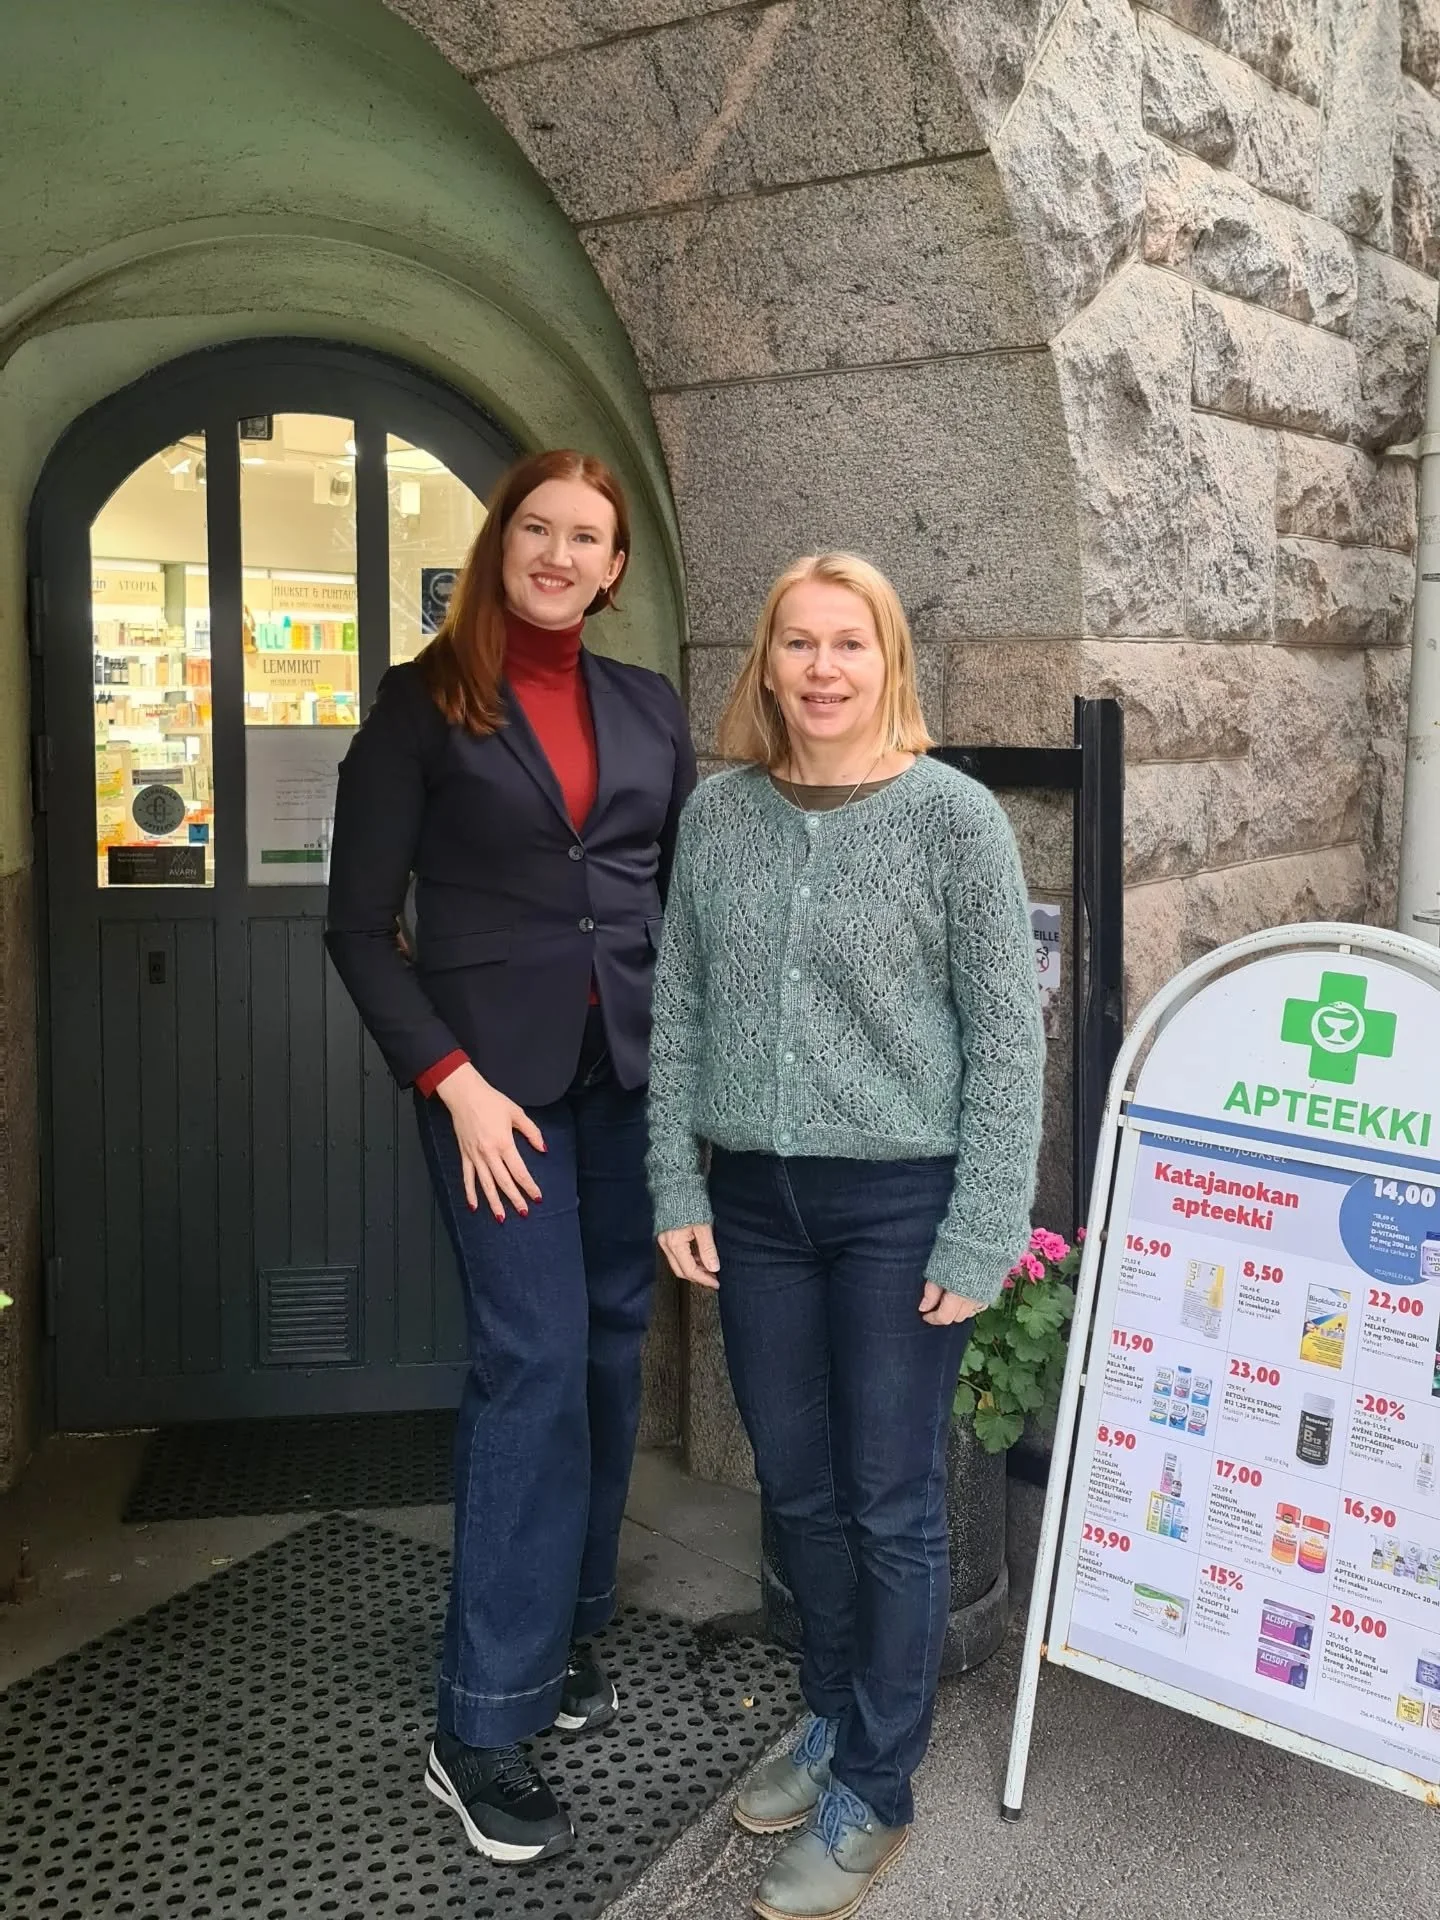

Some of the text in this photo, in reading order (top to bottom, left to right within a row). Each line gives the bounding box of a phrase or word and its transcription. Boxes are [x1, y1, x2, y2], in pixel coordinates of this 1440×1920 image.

[263, 659, 320, 674] LEMMIKIT
[1223, 1082, 1432, 1146] APTEEKKI
[1154, 1162, 1300, 1208] Katajanokan
[1374, 1178, 1436, 1208] 14,00
[1172, 1195, 1274, 1231] apteekki
[1372, 1221, 1399, 1231] DEVISOL
[1126, 1234, 1172, 1258] 16,90
[1138, 1268, 1156, 1278] SUOJA
[1243, 1261, 1283, 1283] 8,50
[1239, 1292, 1270, 1304] BISOLDUO
[1309, 1294, 1336, 1307] Bisolduo
[1368, 1289, 1424, 1317] 22,00
[1113, 1330, 1153, 1353] 11,90
[1364, 1322, 1430, 1343] MELATONIINI ORION
[1229, 1359, 1280, 1386] 23,00
[1226, 1391, 1282, 1411] BETOLVEX STRONG
[1356, 1394, 1405, 1420] -20%
[1098, 1426, 1136, 1450] 8,90
[1351, 1434, 1395, 1450] ANTI-AGEING
[1374, 1432, 1418, 1450] DERMABSOLU
[1350, 1442, 1384, 1455] TUOTTEET
[1092, 1464, 1122, 1478] A-VITAMIN
[1093, 1457, 1118, 1468] MASOLIN
[1091, 1472, 1118, 1484] HOITAVAT
[1217, 1460, 1262, 1487] 17,00
[1089, 1486, 1133, 1504] NENÄSUIHKEET
[1090, 1479, 1133, 1496] KOSTEUTTAVAT
[1211, 1493, 1238, 1504] MINISUN
[1209, 1508, 1230, 1519] VAHVA
[1210, 1500, 1256, 1518] MONIVITAMIINI
[1344, 1498, 1396, 1528] 16,90
[1083, 1523, 1130, 1552] 29,90
[1078, 1563, 1133, 1586] KAKSOISTYRNIÖLJY
[1202, 1564, 1243, 1590] -15%
[1335, 1568, 1366, 1582] APTEEKKI
[1367, 1578, 1401, 1594] FLUACUTE
[1135, 1599, 1163, 1615] Omega7
[1198, 1596, 1223, 1609] ACISOFT
[1266, 1614, 1294, 1628] ACISOFT
[1329, 1604, 1387, 1638] 20,00
[1326, 1640, 1353, 1654] DEVISOL
[1260, 1652, 1289, 1667] ACISOFT
